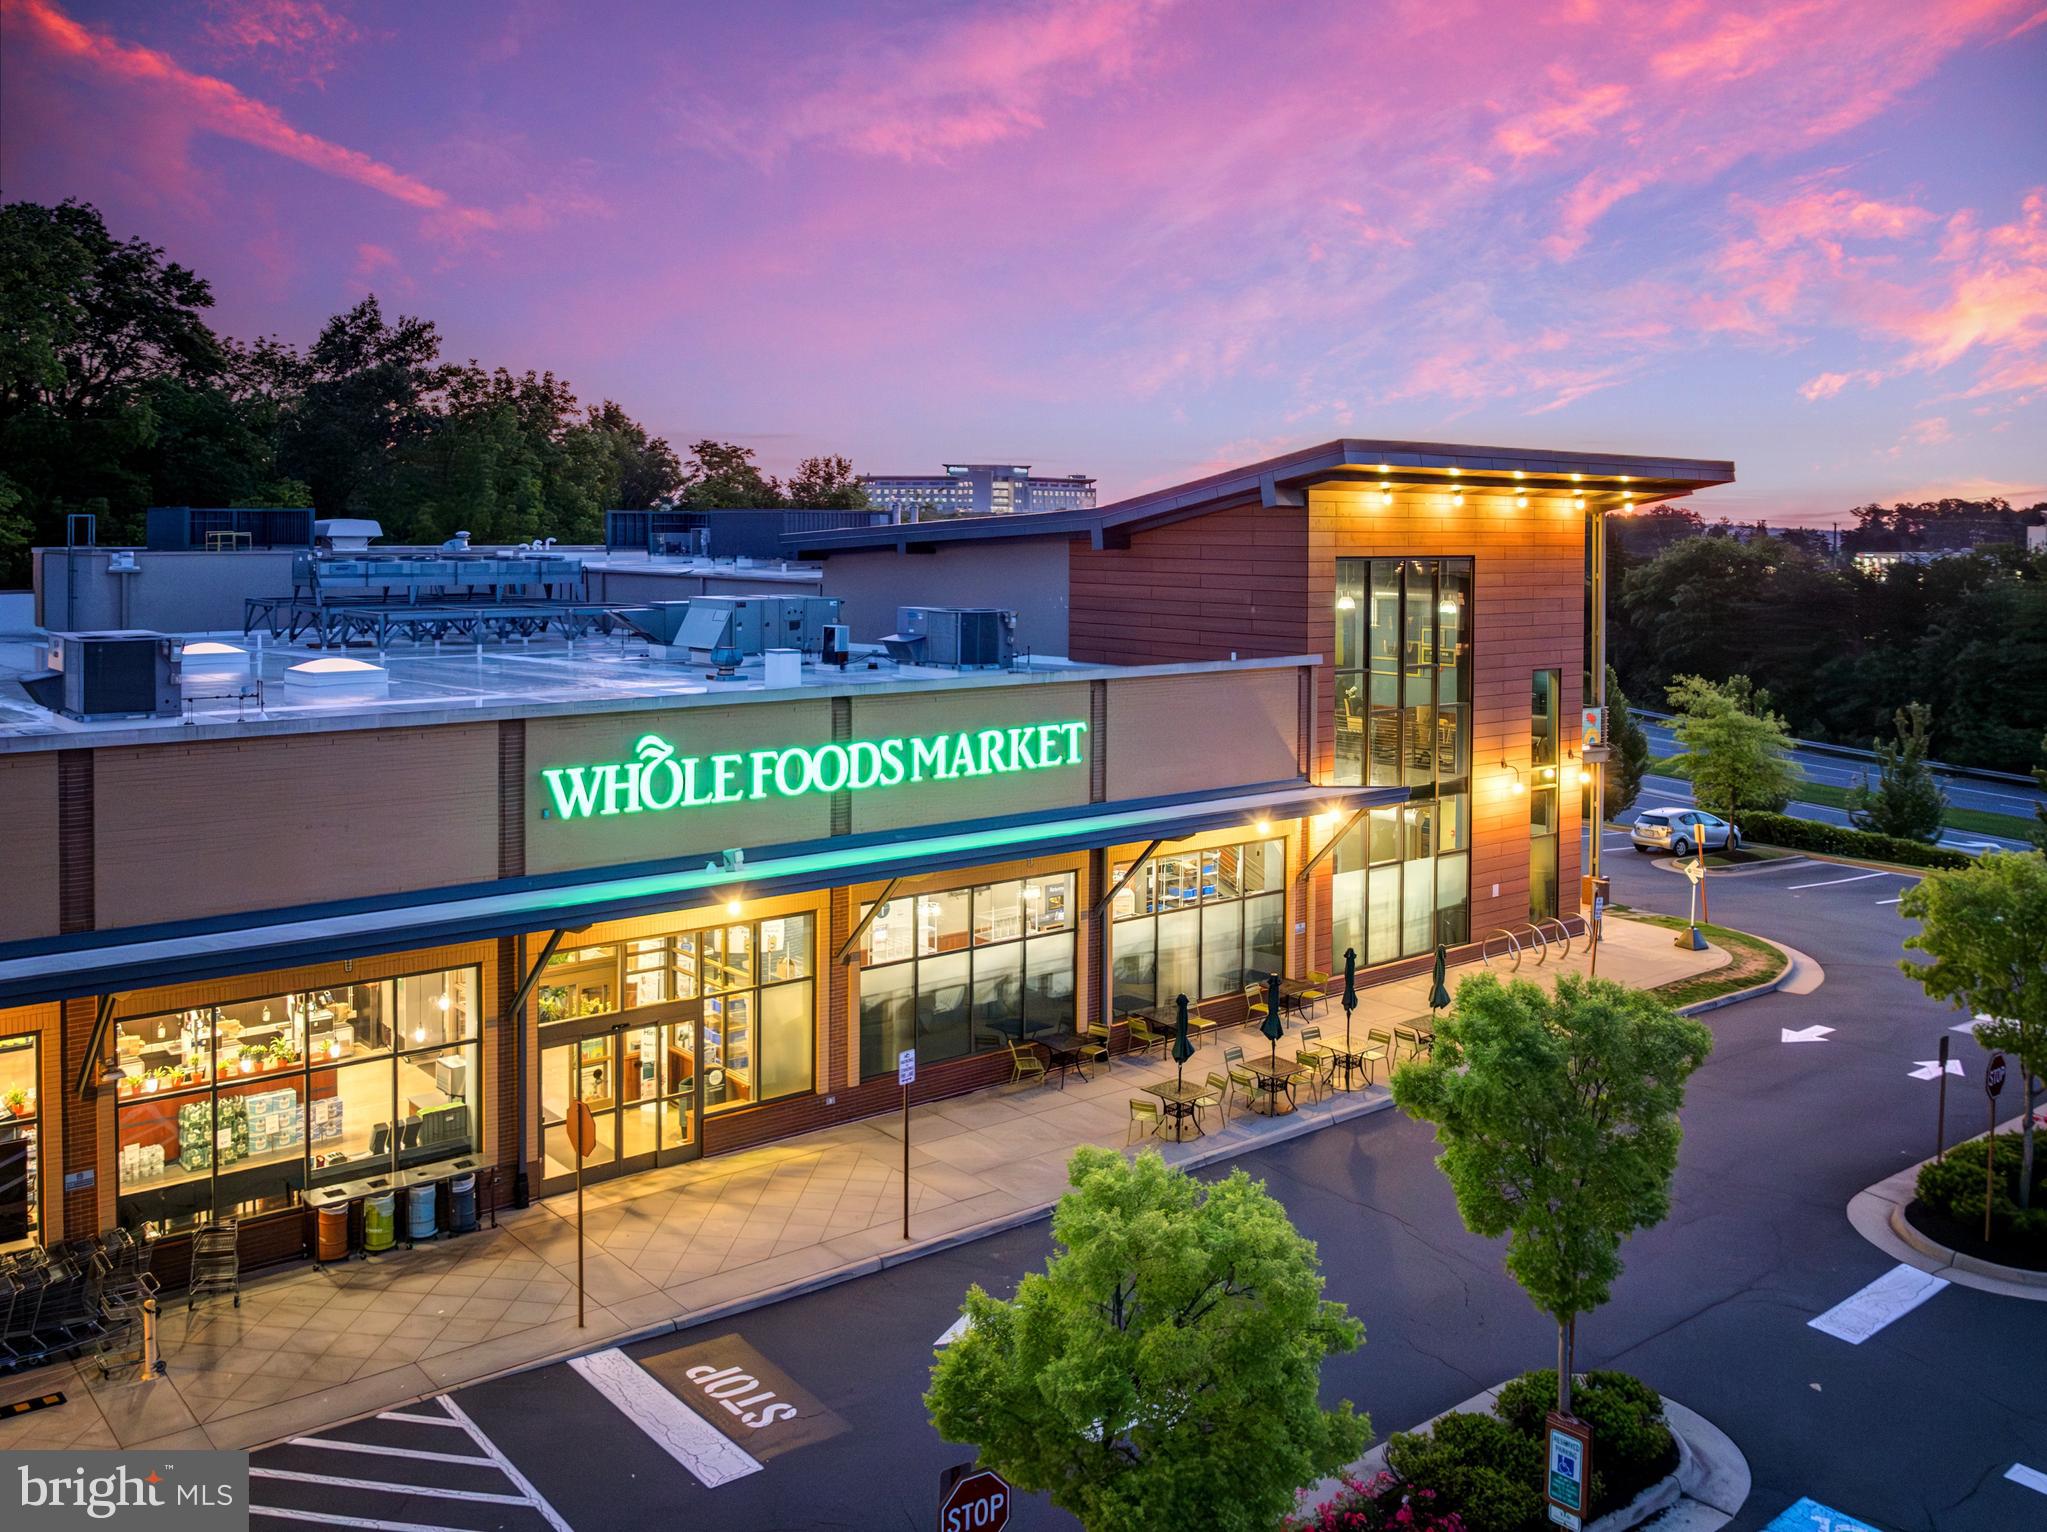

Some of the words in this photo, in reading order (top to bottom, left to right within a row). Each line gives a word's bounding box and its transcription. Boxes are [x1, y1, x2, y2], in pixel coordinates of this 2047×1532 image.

[543, 736, 743, 819] WHOLE
[749, 739, 904, 798] FOODS
[910, 721, 1087, 783] MARKET
[1988, 1066, 2005, 1086] STOP
[686, 1365, 797, 1428] STOP
[947, 1493, 1004, 1532] STOP
